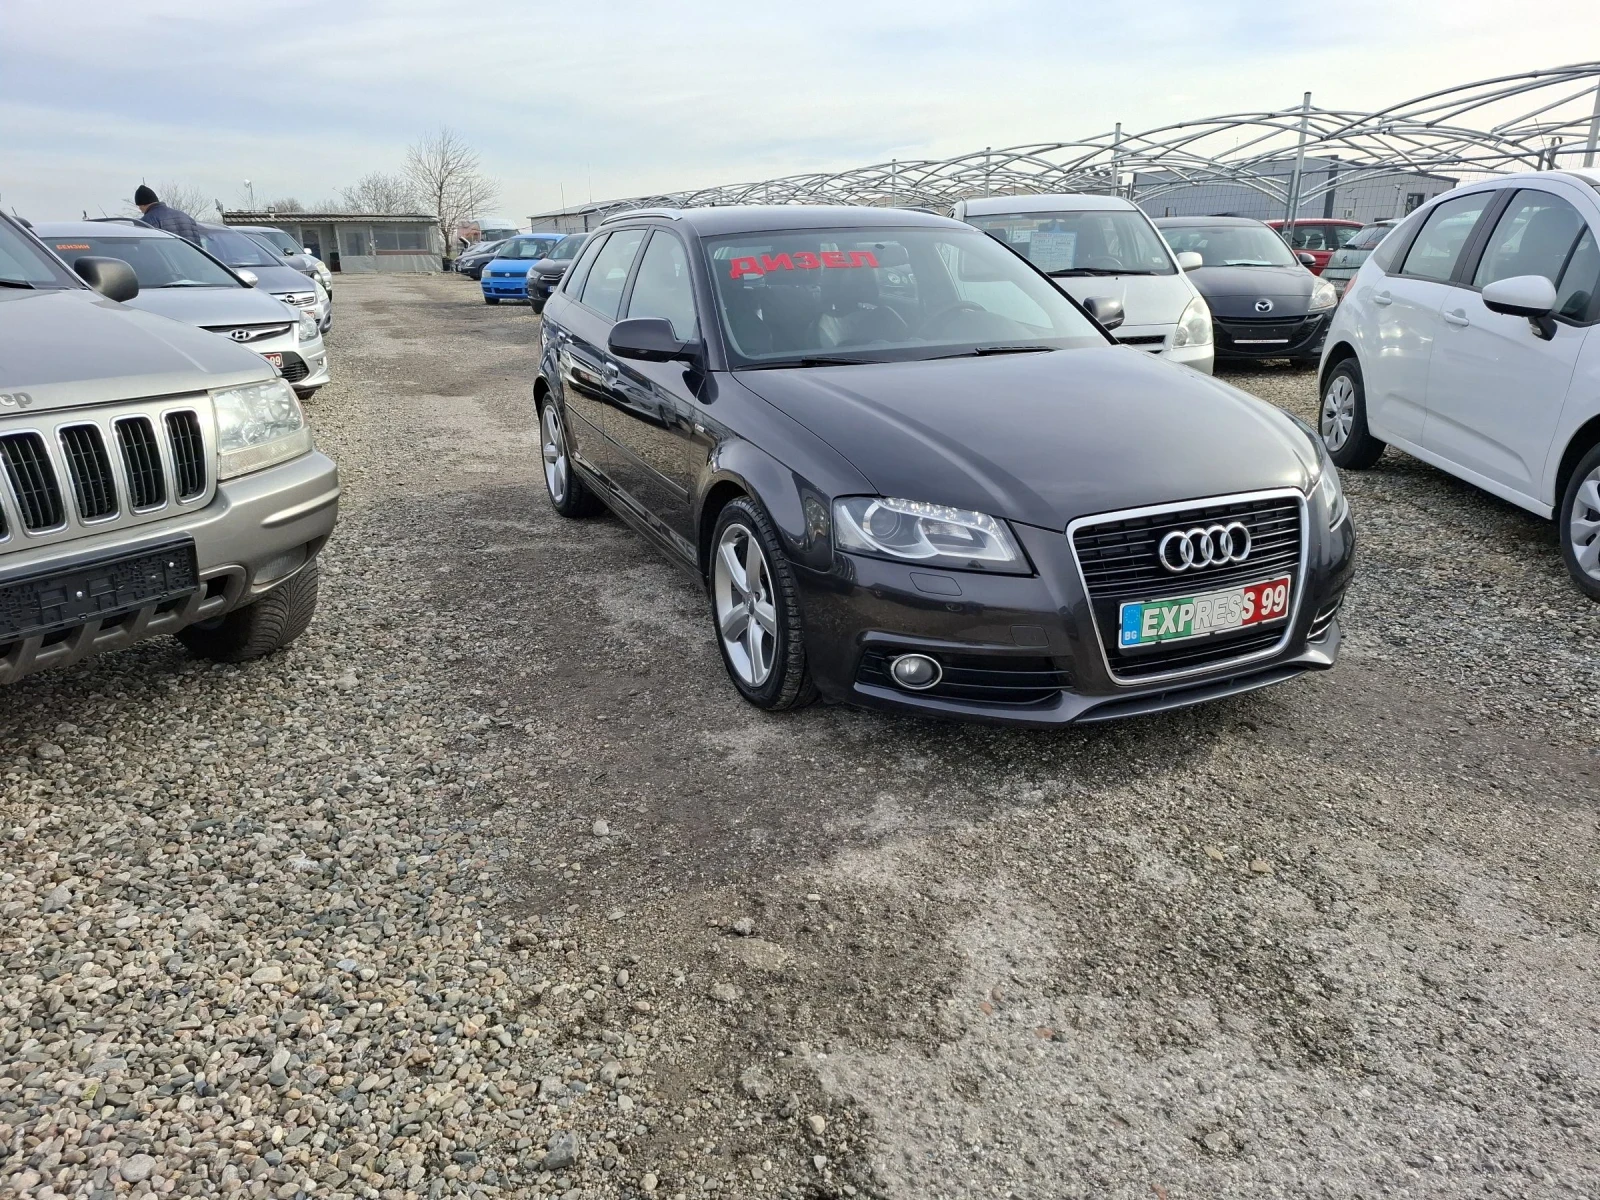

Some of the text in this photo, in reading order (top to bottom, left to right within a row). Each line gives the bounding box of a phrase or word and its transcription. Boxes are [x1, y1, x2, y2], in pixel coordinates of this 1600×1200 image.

[729, 251, 879, 279] ДИЗЕЛ
[1141, 584, 1286, 637] EXPRESS 99
[1124, 630, 1138, 641] BG
